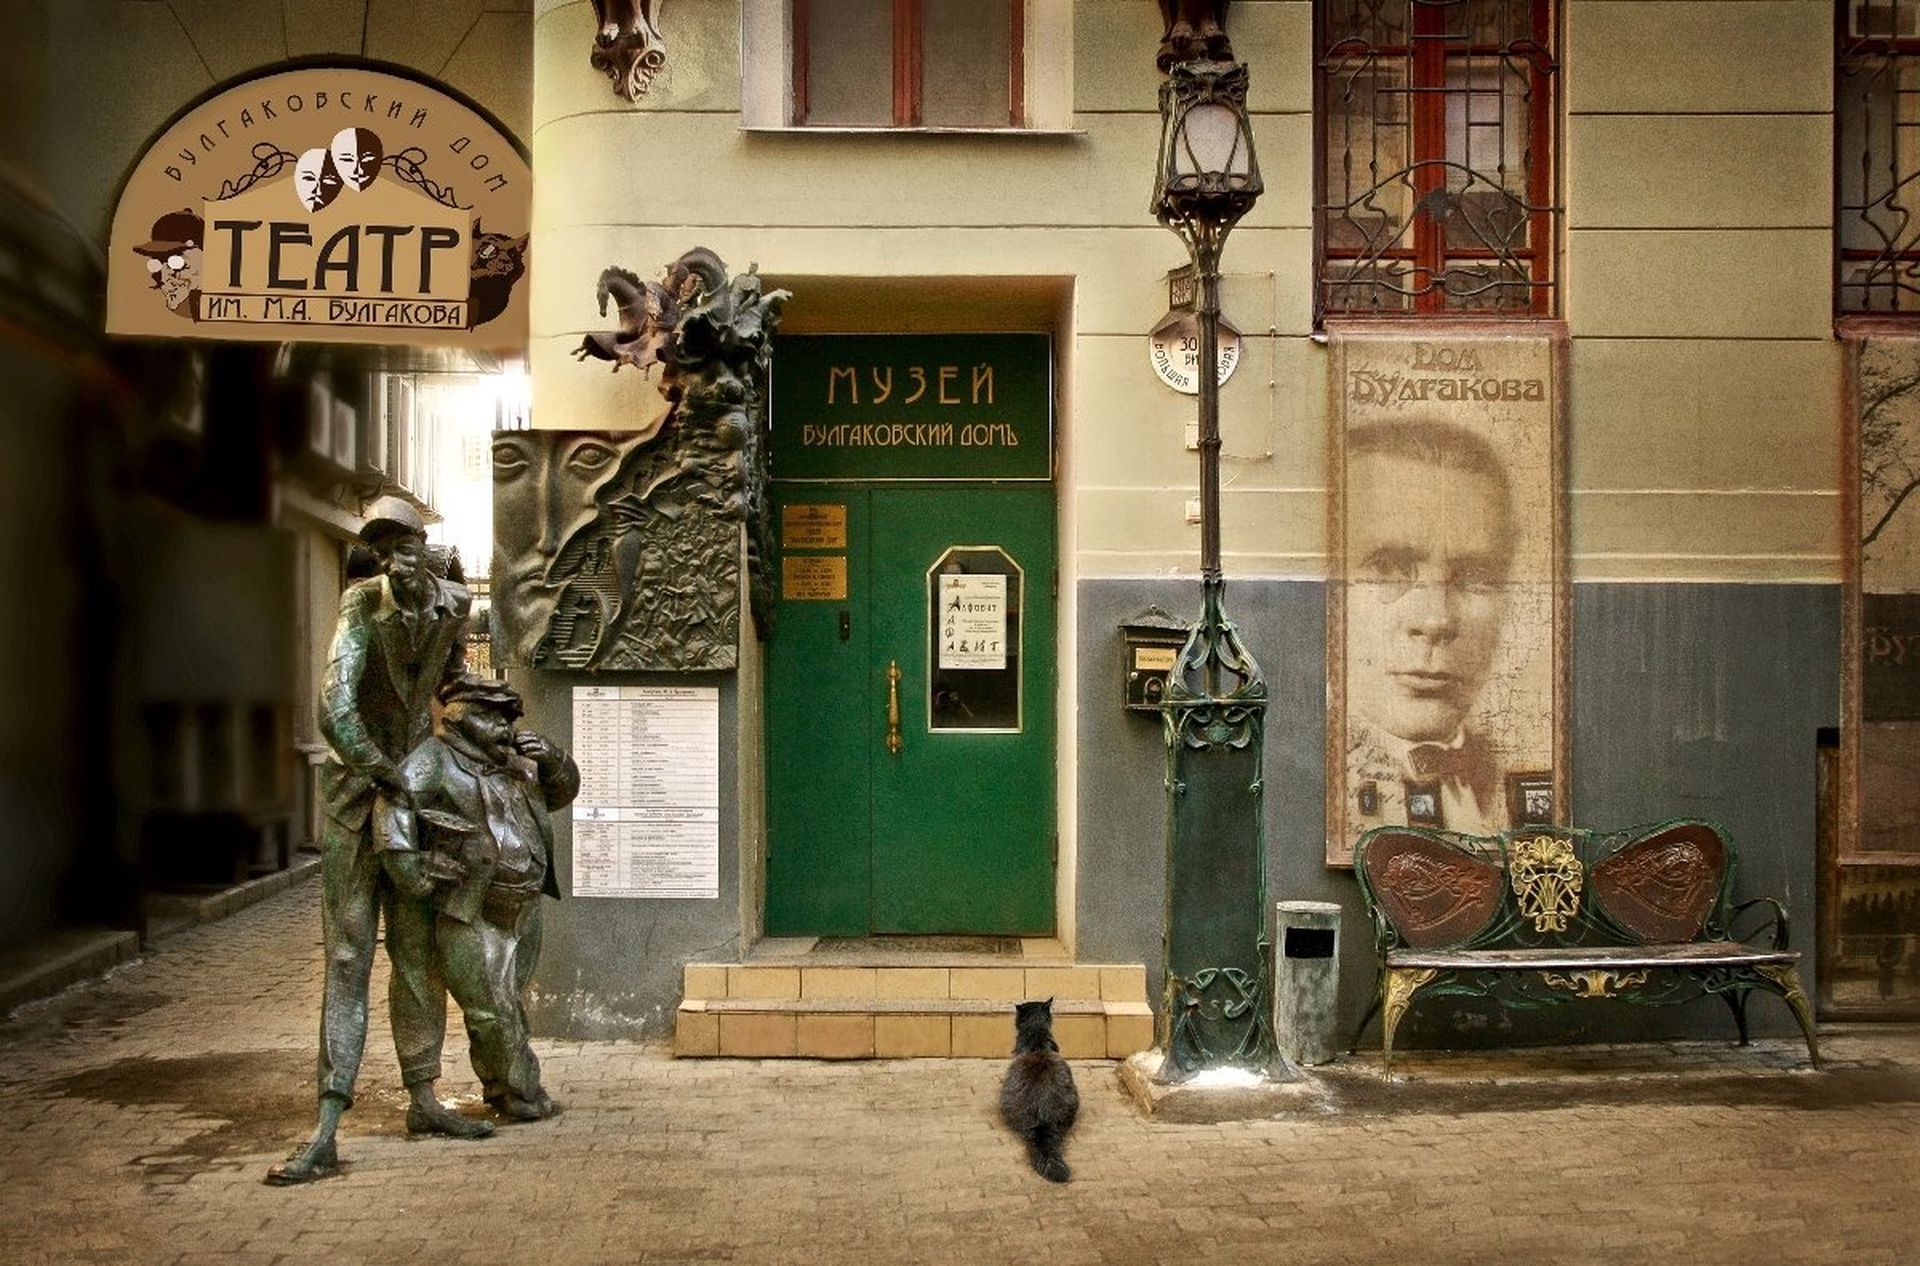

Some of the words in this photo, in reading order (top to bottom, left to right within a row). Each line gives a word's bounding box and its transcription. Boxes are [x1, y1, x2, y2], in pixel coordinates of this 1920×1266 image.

[164, 91, 428, 182] БУЛГАКОВСКИЙ
[449, 136, 509, 193] ДОМ
[213, 220, 461, 294] ТЕАТР
[208, 298, 247, 319] ИМ.
[263, 298, 312, 321] М.А.
[328, 301, 462, 325] БУЛГАКОВА
[1180, 337, 1198, 352] 30
[828, 362, 995, 405] МУЗЕЙ
[1350, 365, 1546, 407] Булгакова
[803, 421, 954, 447] БУЛГАКОВСКИЙ
[960, 423, 1019, 446] ДОМЪ
